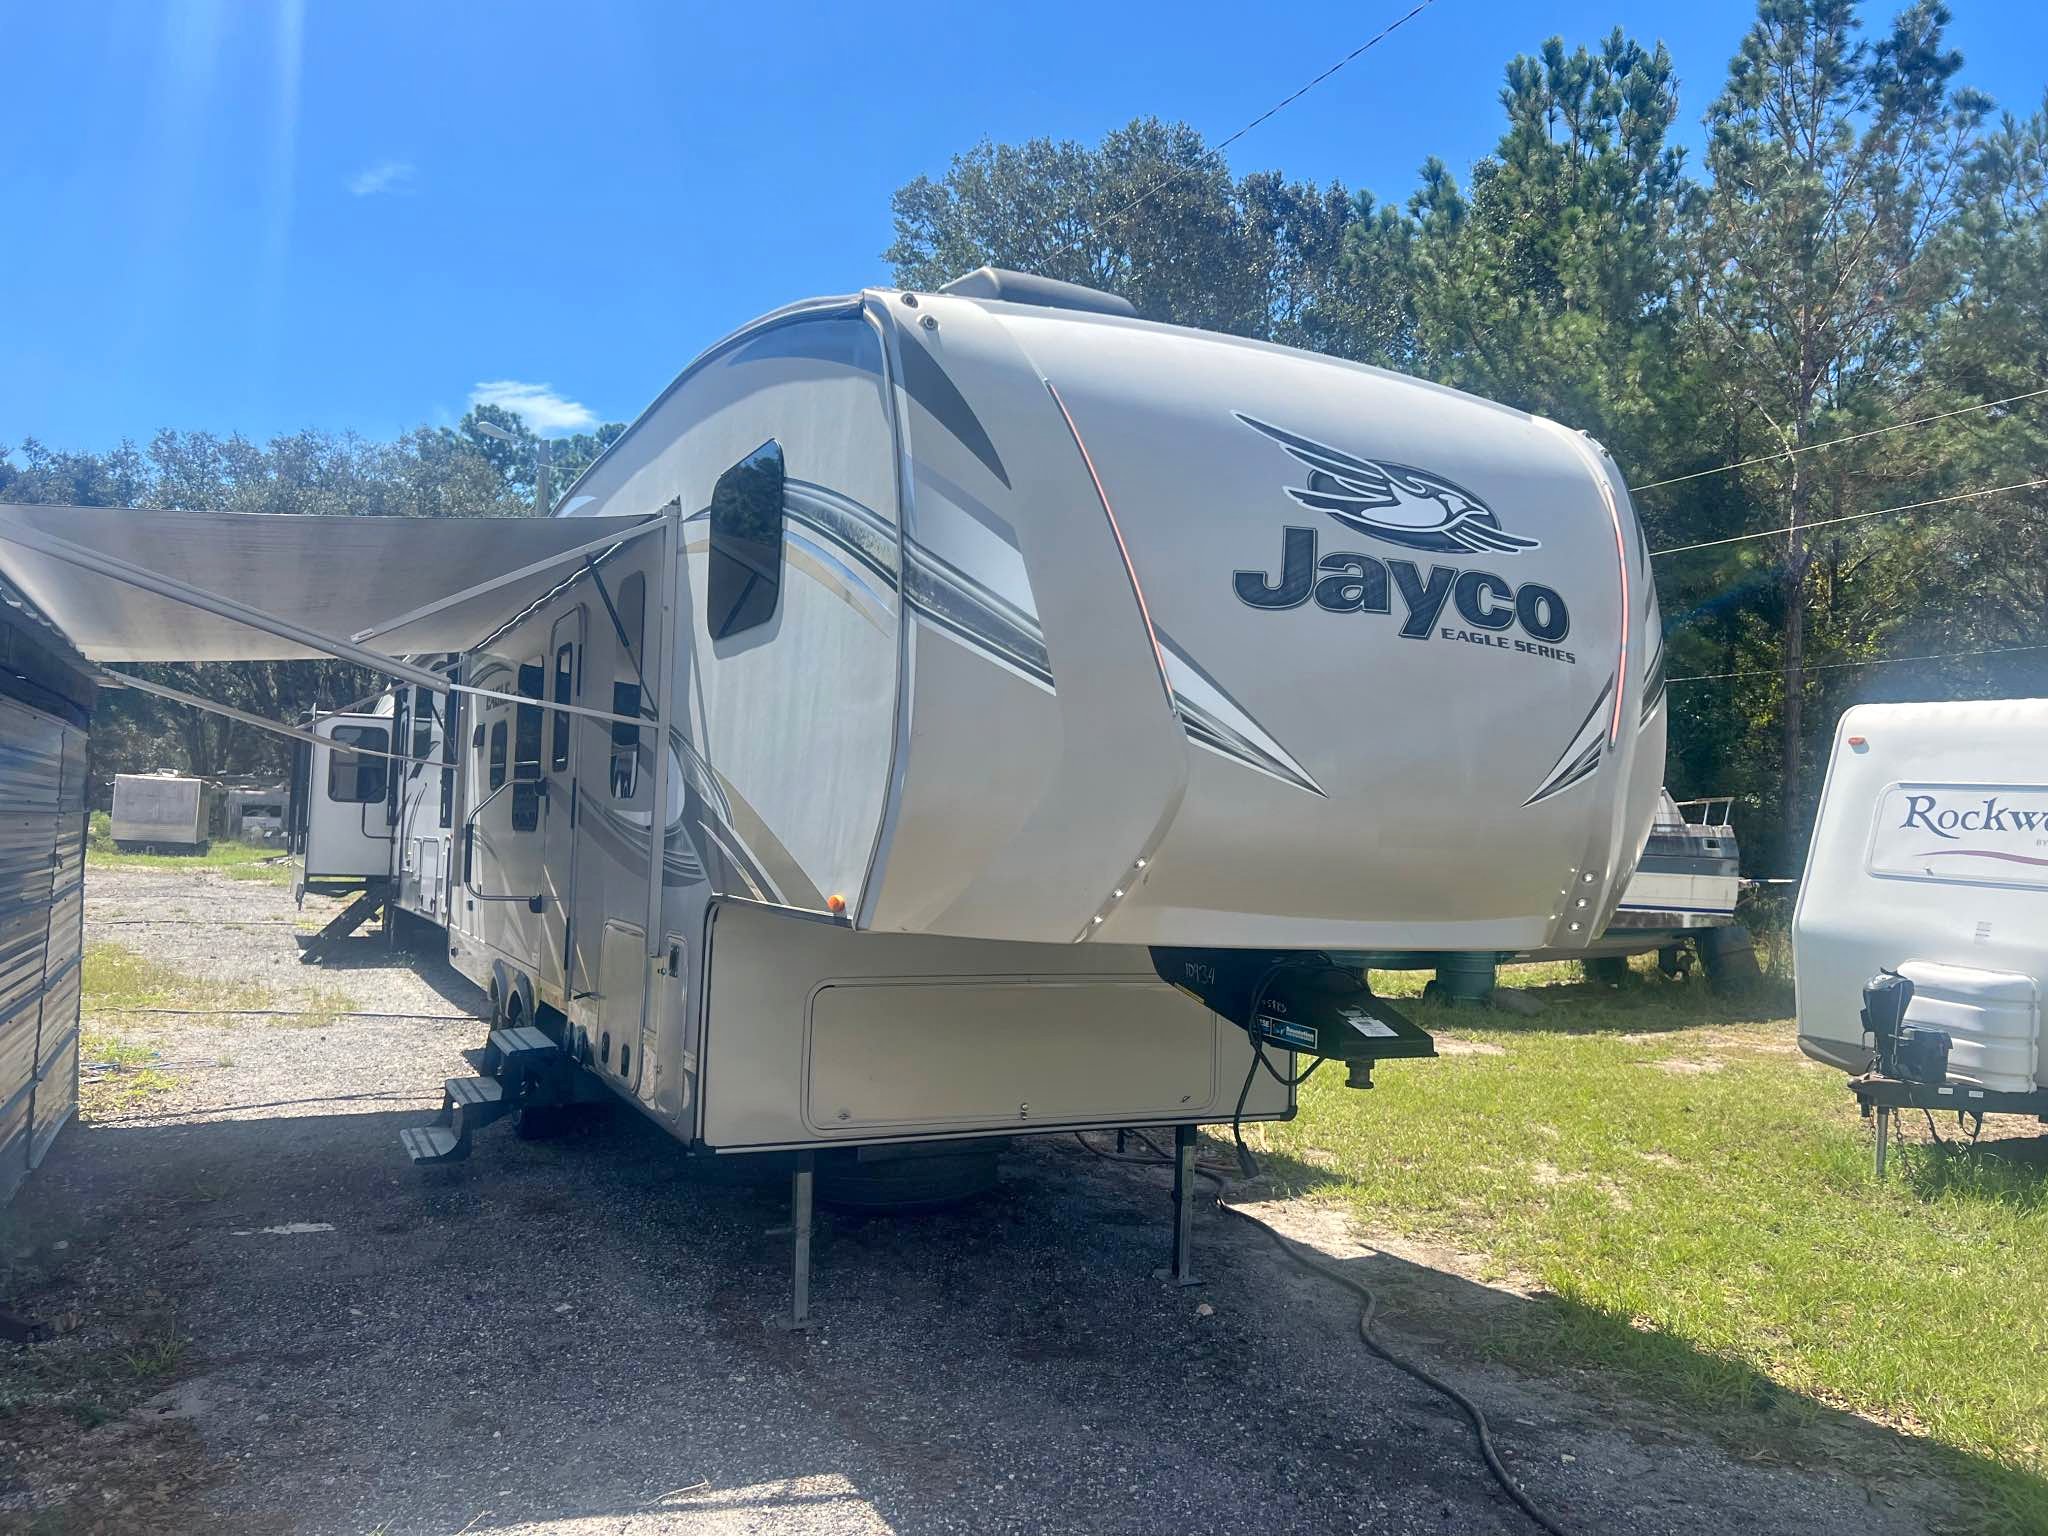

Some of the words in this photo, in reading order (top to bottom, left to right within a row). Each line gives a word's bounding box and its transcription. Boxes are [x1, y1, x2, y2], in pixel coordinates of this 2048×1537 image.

[1233, 525, 1570, 643] Jayco
[1441, 627, 1510, 649] EAGLE
[1514, 640, 1576, 665] SERIES
